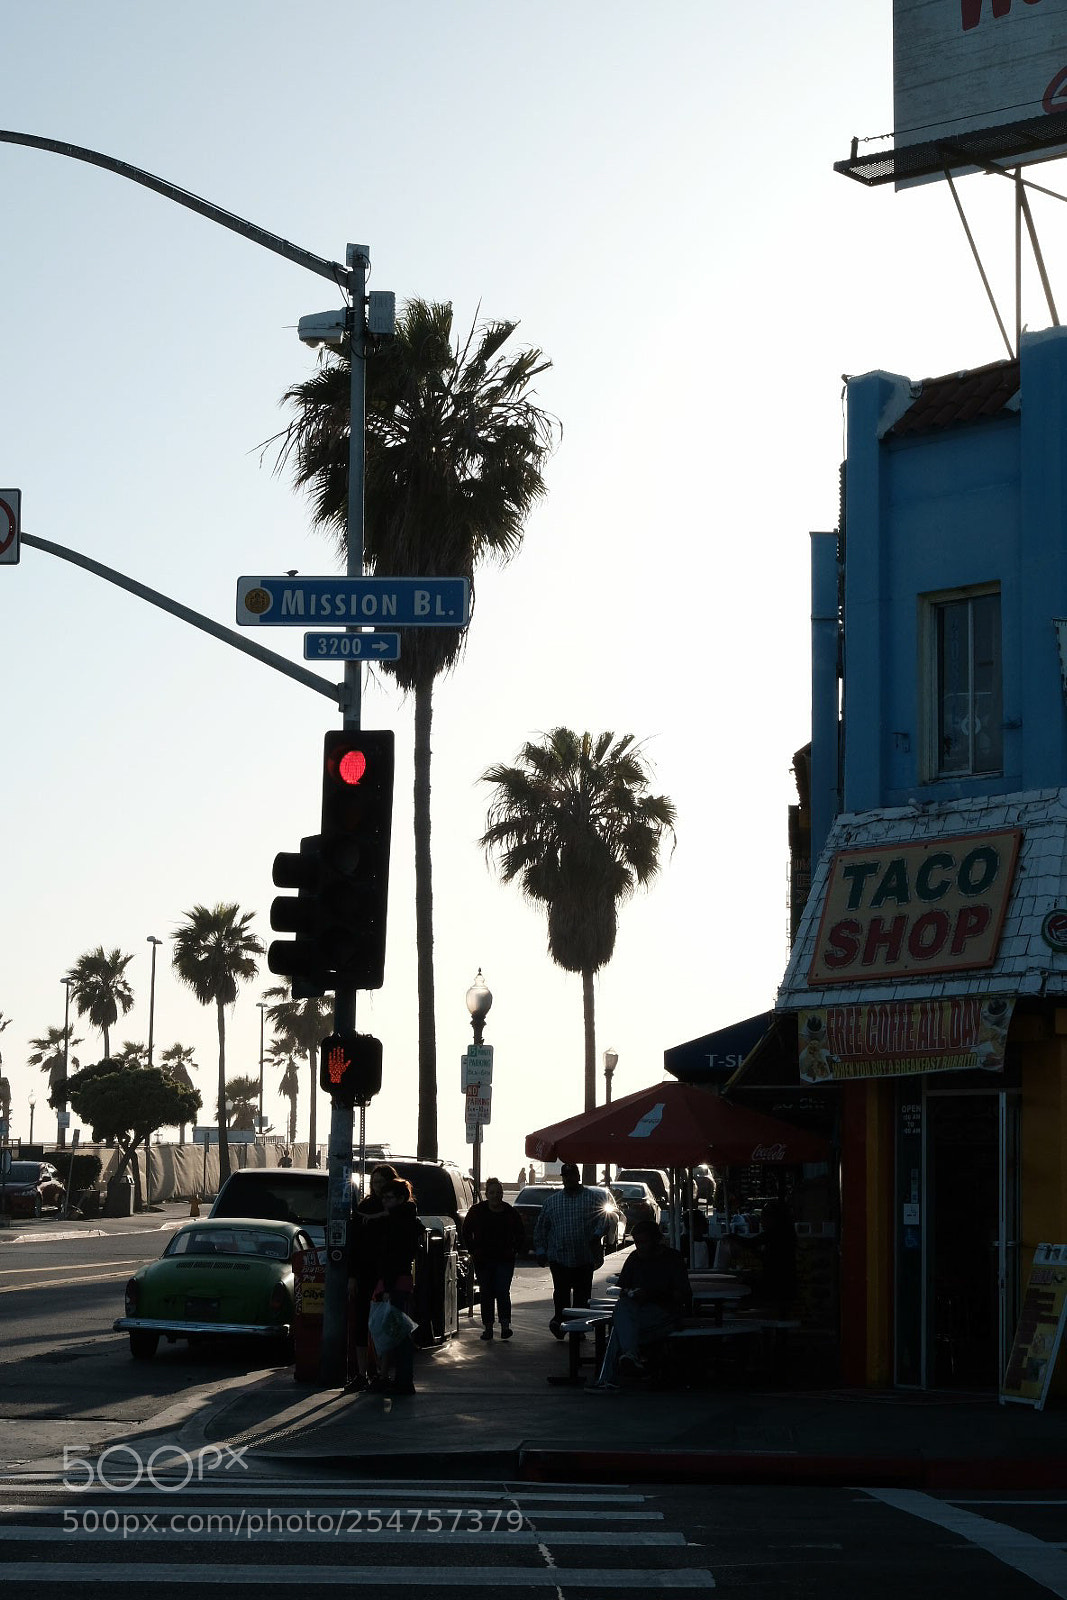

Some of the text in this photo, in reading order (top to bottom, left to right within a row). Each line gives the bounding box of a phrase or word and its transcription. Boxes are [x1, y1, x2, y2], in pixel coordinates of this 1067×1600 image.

[317, 637, 362, 655] 3200
[842, 845, 1000, 911] TACO
[823, 903, 992, 969] SHOP
[826, 999, 983, 1056] FREE COFFE ALL DAY
[855, 1060, 870, 1077] YOU
[871, 1059, 886, 1075] BUY
[894, 1056, 941, 1074] BREAKFAST
[941, 1052, 977, 1070] BURRITO
[901, 1104, 922, 1113] OPEN
